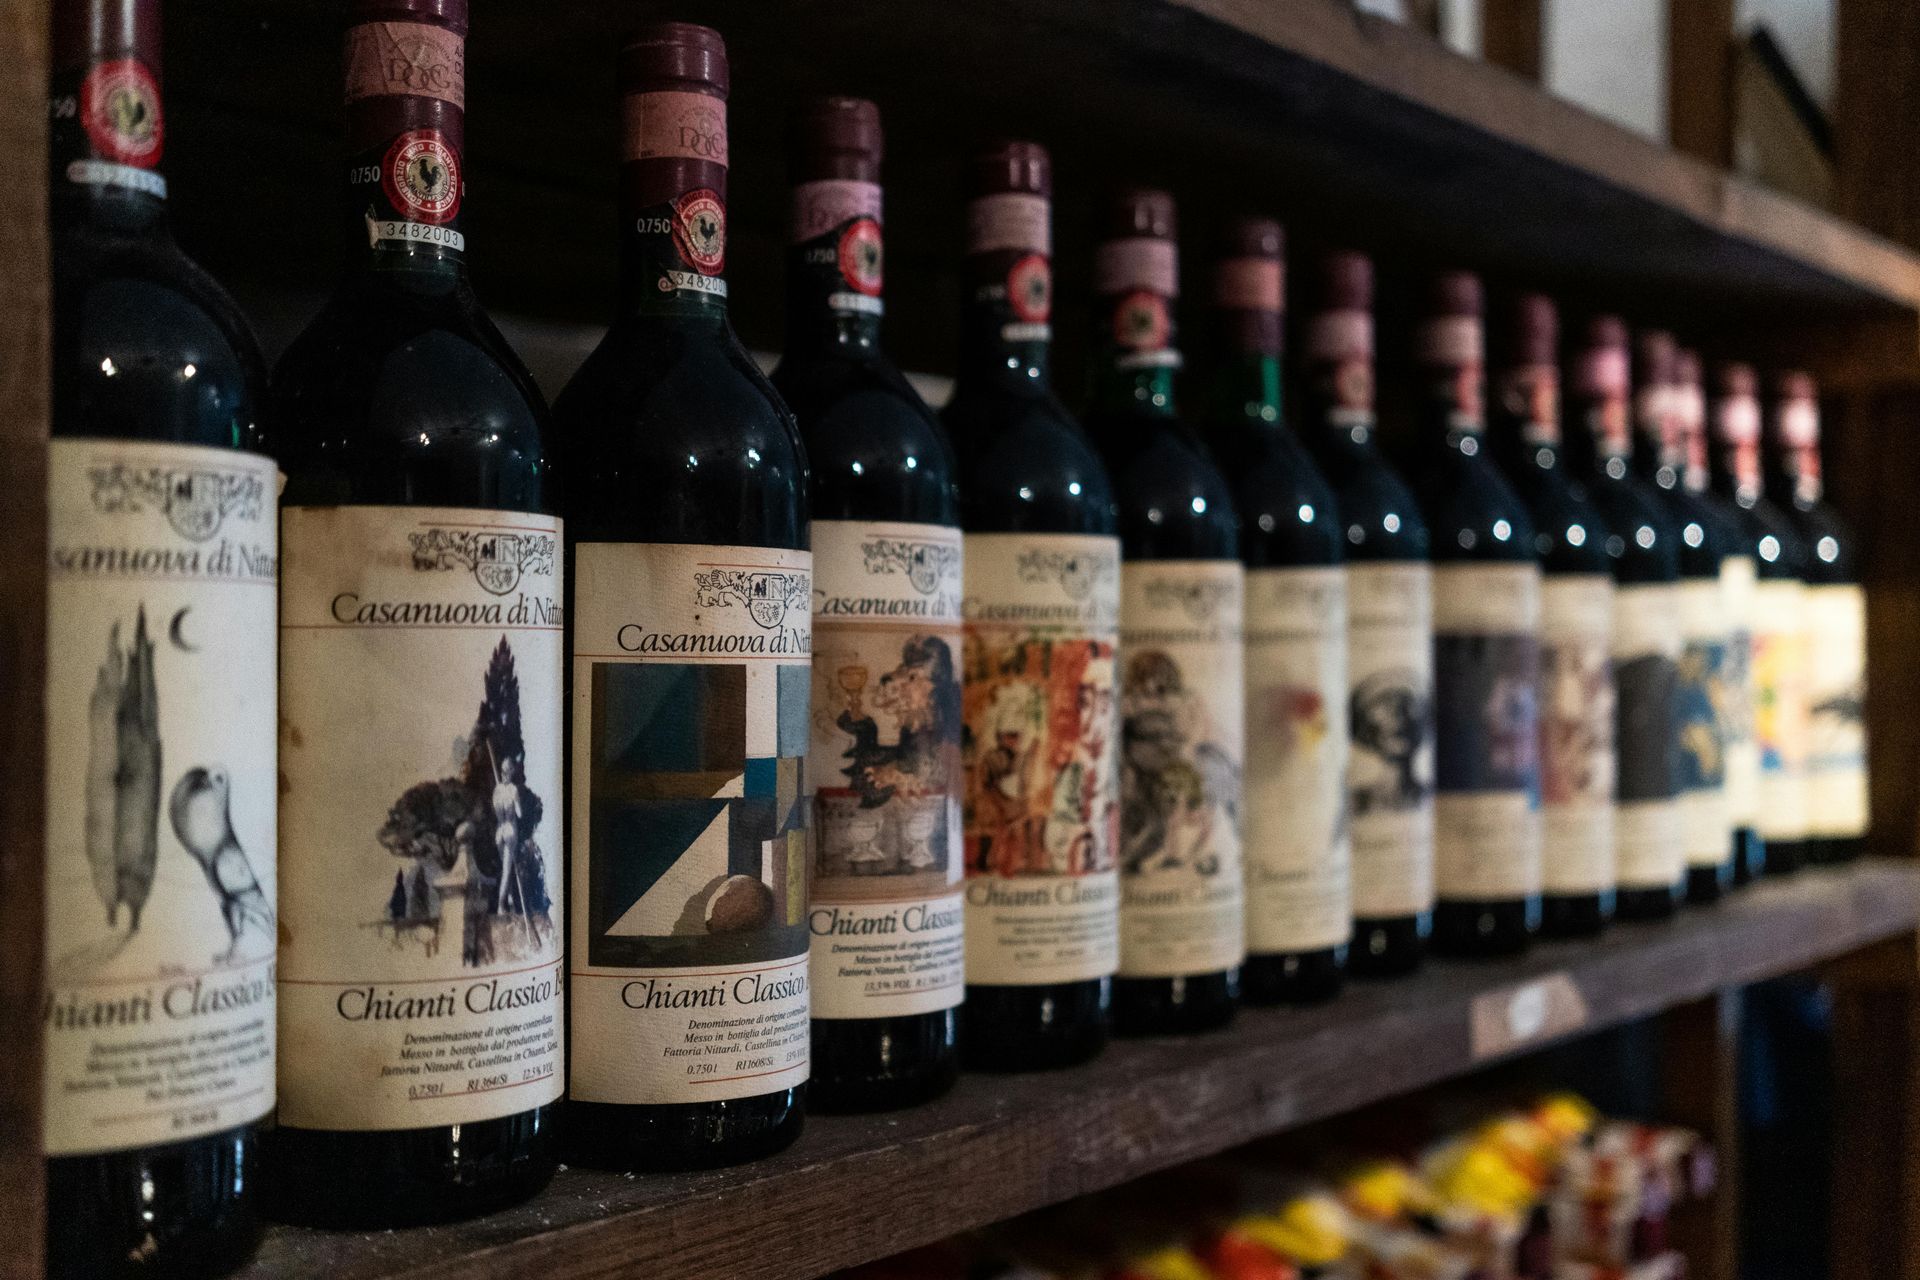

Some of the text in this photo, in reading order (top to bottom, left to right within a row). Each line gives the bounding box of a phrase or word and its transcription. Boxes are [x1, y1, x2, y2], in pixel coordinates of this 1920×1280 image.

[386, 222, 459, 246] 3482003
[331, 592, 500, 625] Casanuova
[507, 593, 529, 625] di
[617, 624, 766, 654] Casanuova
[769, 625, 788, 654] di
[809, 908, 898, 936] Chianti
[337, 987, 456, 1021] Chianti
[465, 975, 551, 1014] Classico
[621, 979, 727, 1009] Chianti
[733, 972, 804, 1005] Classico
[688, 1017, 755, 1030] Denominazione
[756, 1014, 764, 1024] di
[765, 1012, 785, 1024] origine
[405, 1029, 483, 1045] Denominazione
[485, 1025, 494, 1038] di
[495, 1022, 522, 1037] origine
[684, 1033, 713, 1044] Messo
[715, 1032, 724, 1042] in
[727, 1028, 759, 1041] bottiglia
[761, 1026, 773, 1037] dal
[399, 1046, 433, 1060] Messo
[435, 1045, 446, 1058] in
[450, 1040, 489, 1058] bottiglia
[491, 1038, 506, 1053] dal
[663, 1046, 701, 1057] Fattoria
[745, 1037, 782, 1052] Castellina
[468, 1054, 513, 1071] Castellina
[514, 1051, 522, 1062] in
